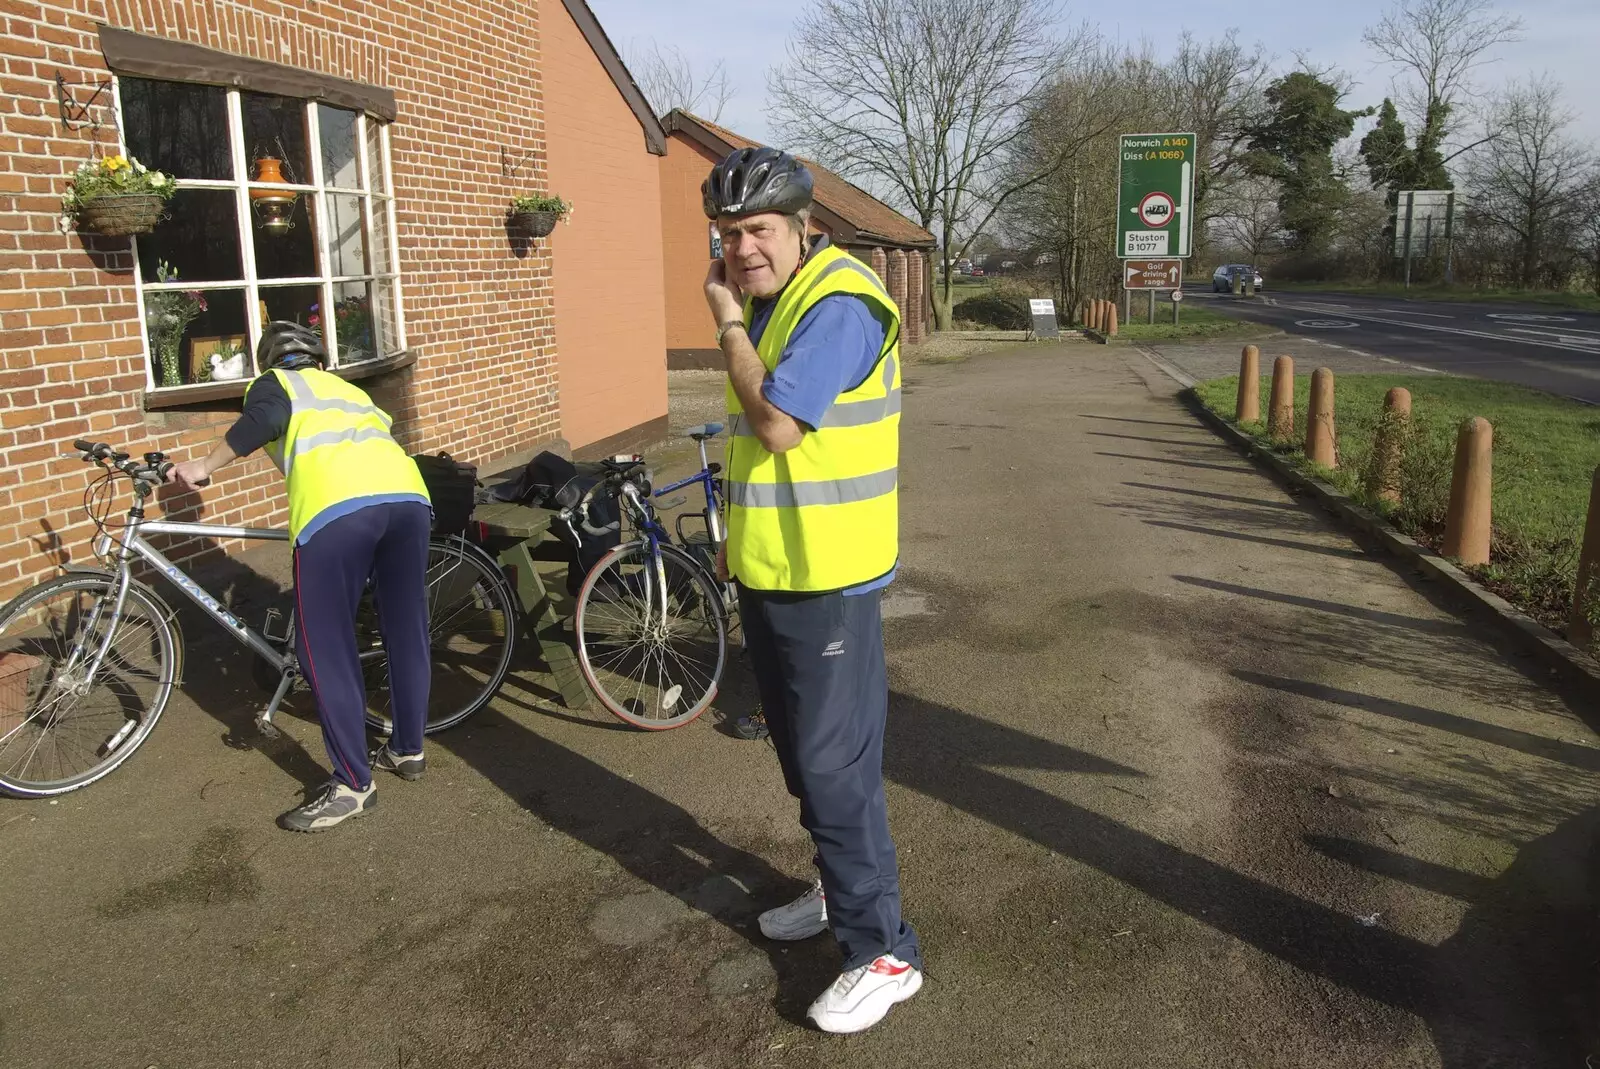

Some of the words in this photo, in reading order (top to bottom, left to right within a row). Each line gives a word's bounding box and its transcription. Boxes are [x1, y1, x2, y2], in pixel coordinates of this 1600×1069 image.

[1124, 139, 1161, 148] Norwich
[1163, 139, 1170, 147] A
[1172, 138, 1188, 146] 140
[1124, 152, 1143, 160] Diss
[1145, 151, 1156, 160] (A
[1159, 150, 1184, 160] 1066)
[1128, 233, 1165, 242] Stuston
[1136, 243, 1157, 251] 1077
[1142, 270, 1167, 279] driving
[167, 567, 243, 629] MARN
